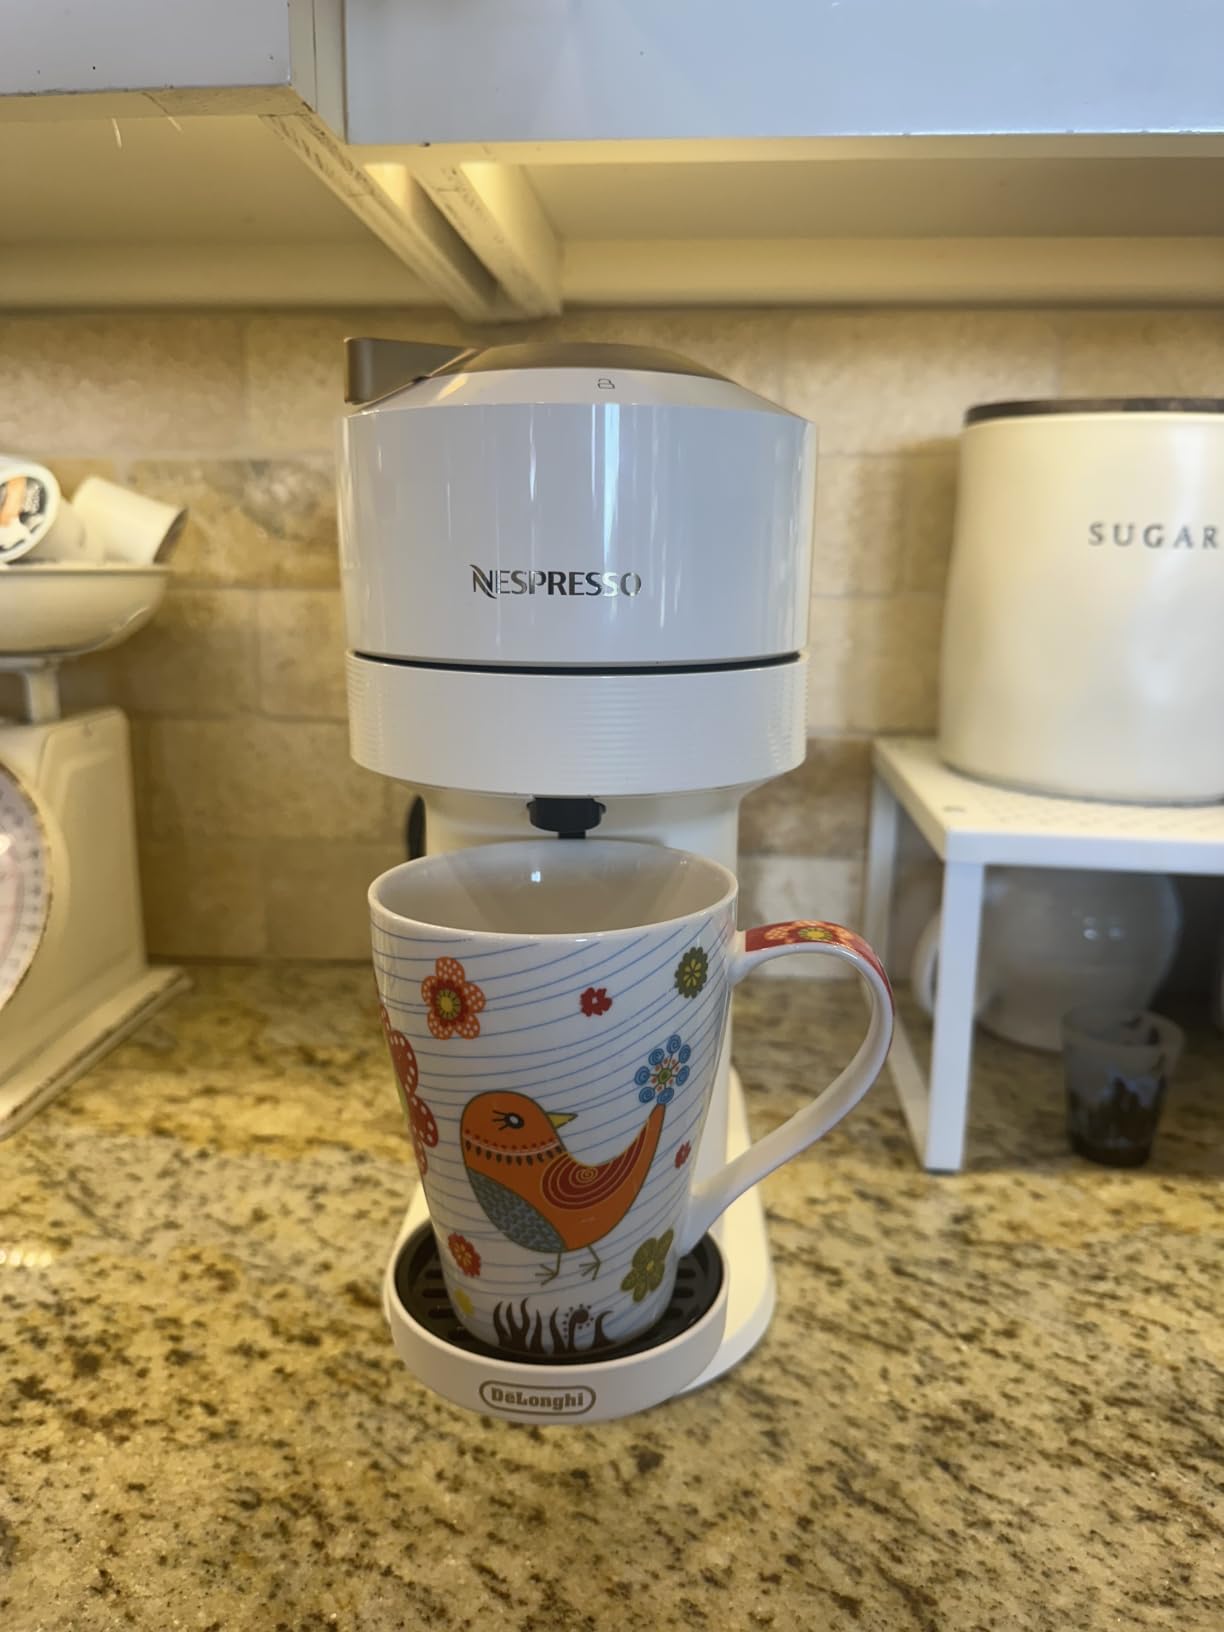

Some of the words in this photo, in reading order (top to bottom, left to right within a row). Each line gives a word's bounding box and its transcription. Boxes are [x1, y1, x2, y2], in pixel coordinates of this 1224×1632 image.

[1088, 521, 1218, 549] SUGAR
[469, 564, 642, 599] NESPRESSO
[490, 1387, 584, 1411] DeLonghi
